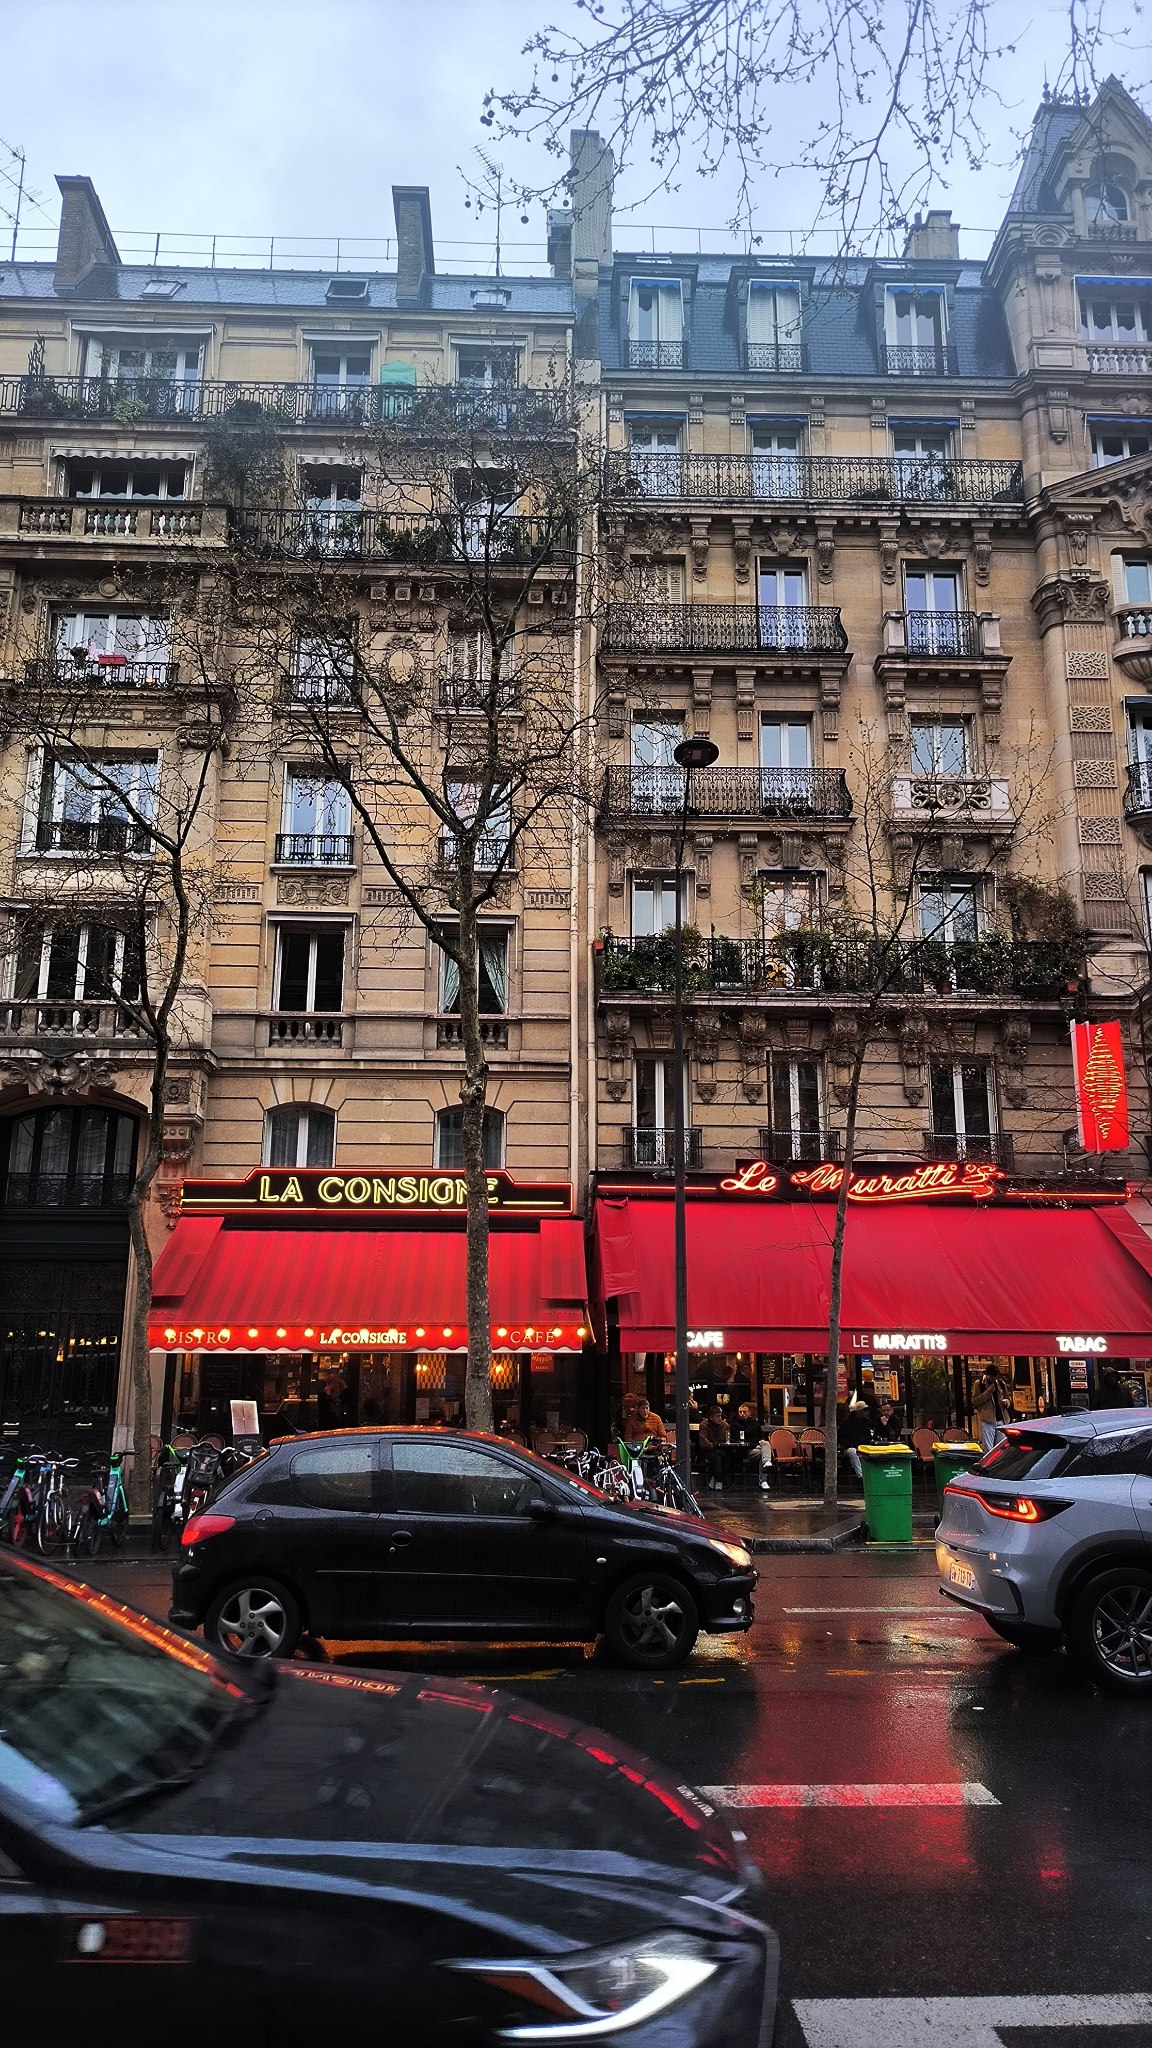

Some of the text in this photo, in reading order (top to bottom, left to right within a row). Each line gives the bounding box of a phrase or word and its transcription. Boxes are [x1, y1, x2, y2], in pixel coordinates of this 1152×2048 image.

[720, 1161, 777, 1192] Le
[259, 1175, 304, 1202] LA
[165, 1331, 231, 1344] BISTRO
[319, 1332, 407, 1344] LA CONSIGNE
[510, 1329, 555, 1343] CAFÉ
[852, 1334, 870, 1348] LE
[1055, 1336, 1108, 1353] TABAC
